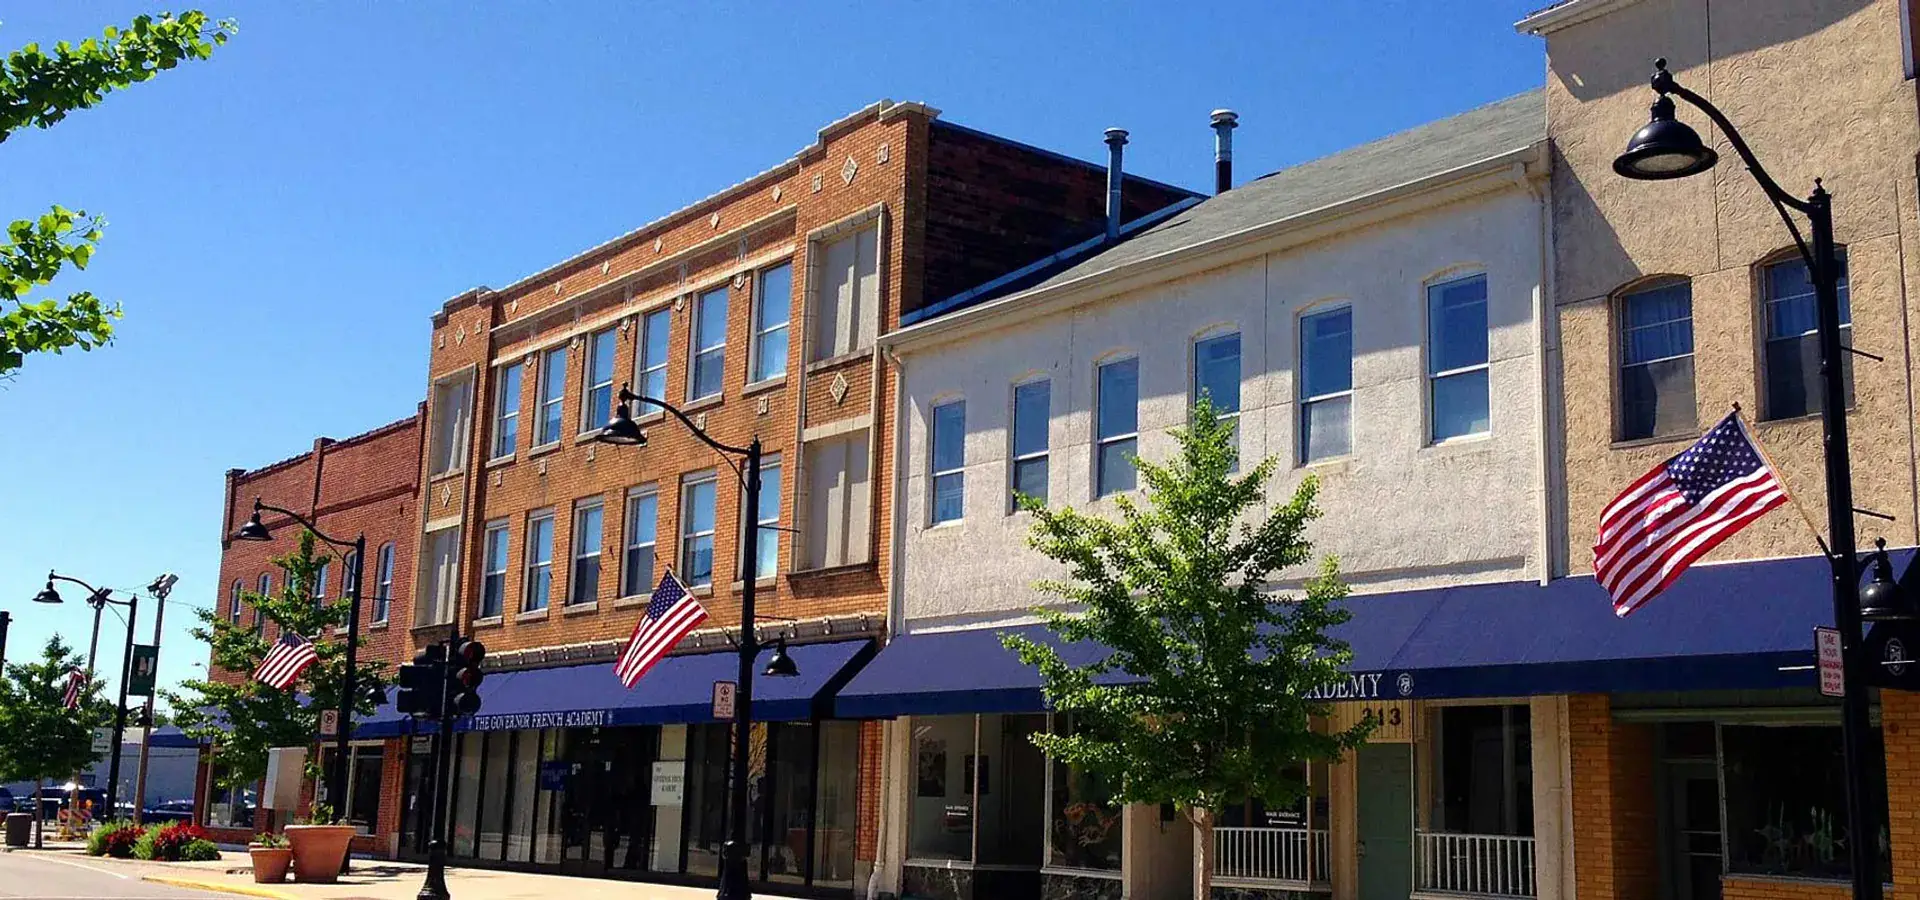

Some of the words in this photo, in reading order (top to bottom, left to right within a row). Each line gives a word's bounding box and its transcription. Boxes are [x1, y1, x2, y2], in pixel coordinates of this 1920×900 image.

[1301, 673, 1382, 699] ADEMY
[475, 716, 490, 731] THE
[490, 714, 530, 730] GOVERNOR
[531, 712, 563, 729] FRENCH
[564, 710, 605, 727] ACADEMY
